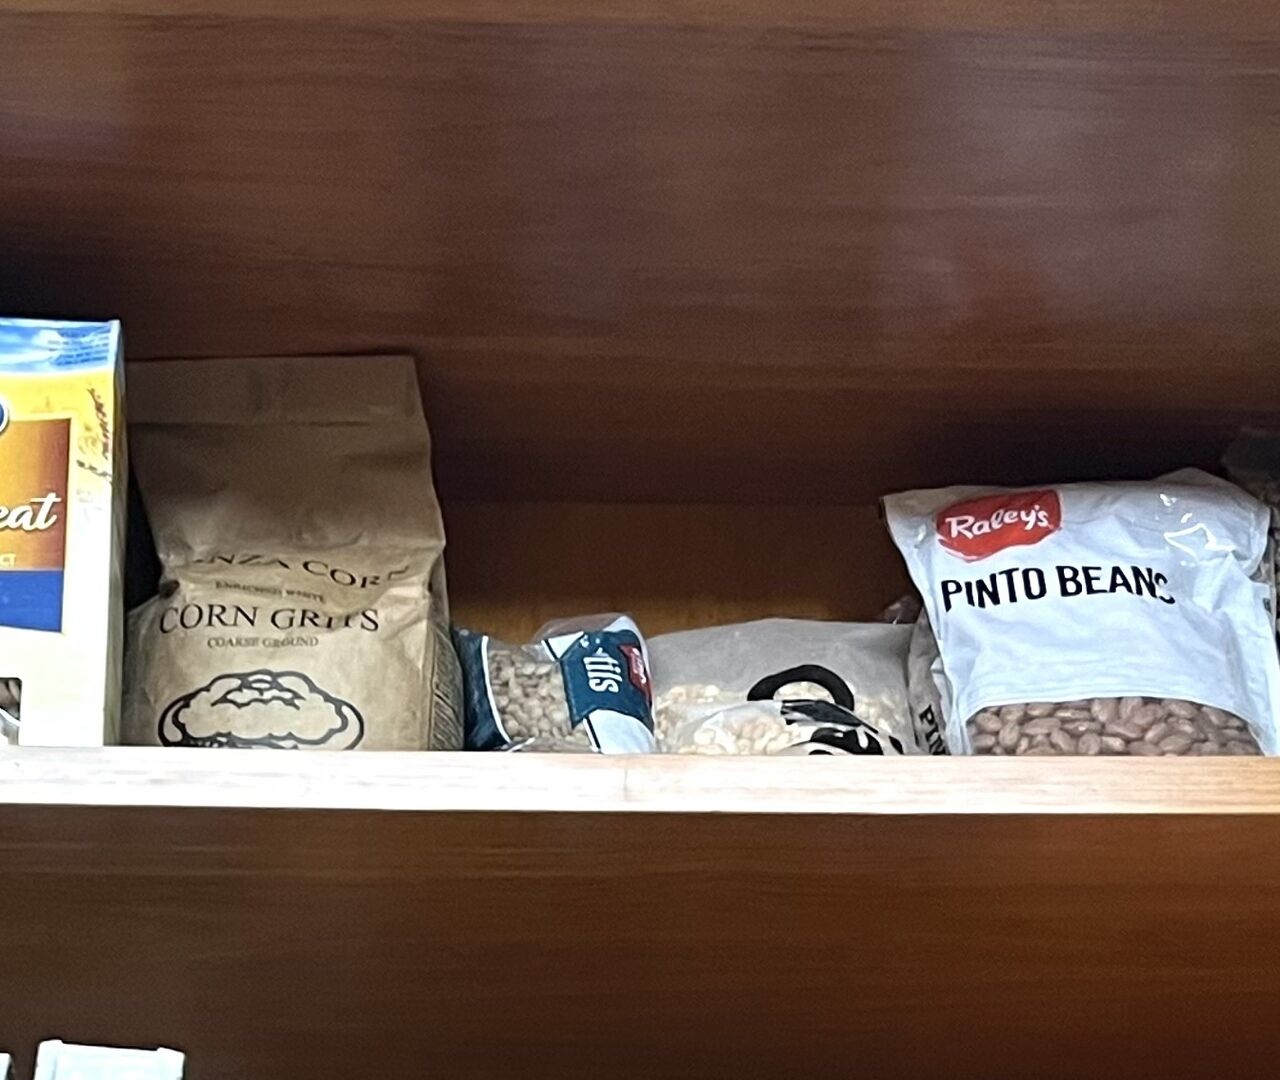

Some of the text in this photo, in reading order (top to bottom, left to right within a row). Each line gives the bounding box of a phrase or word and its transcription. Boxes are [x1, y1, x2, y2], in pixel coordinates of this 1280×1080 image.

[945, 503, 1051, 540] Raley's
[941, 565, 1176, 612] PINTO BEANS
[159, 603, 257, 634] CORN
[262, 636, 320, 649] GROUND
[583, 647, 623, 693] tils
